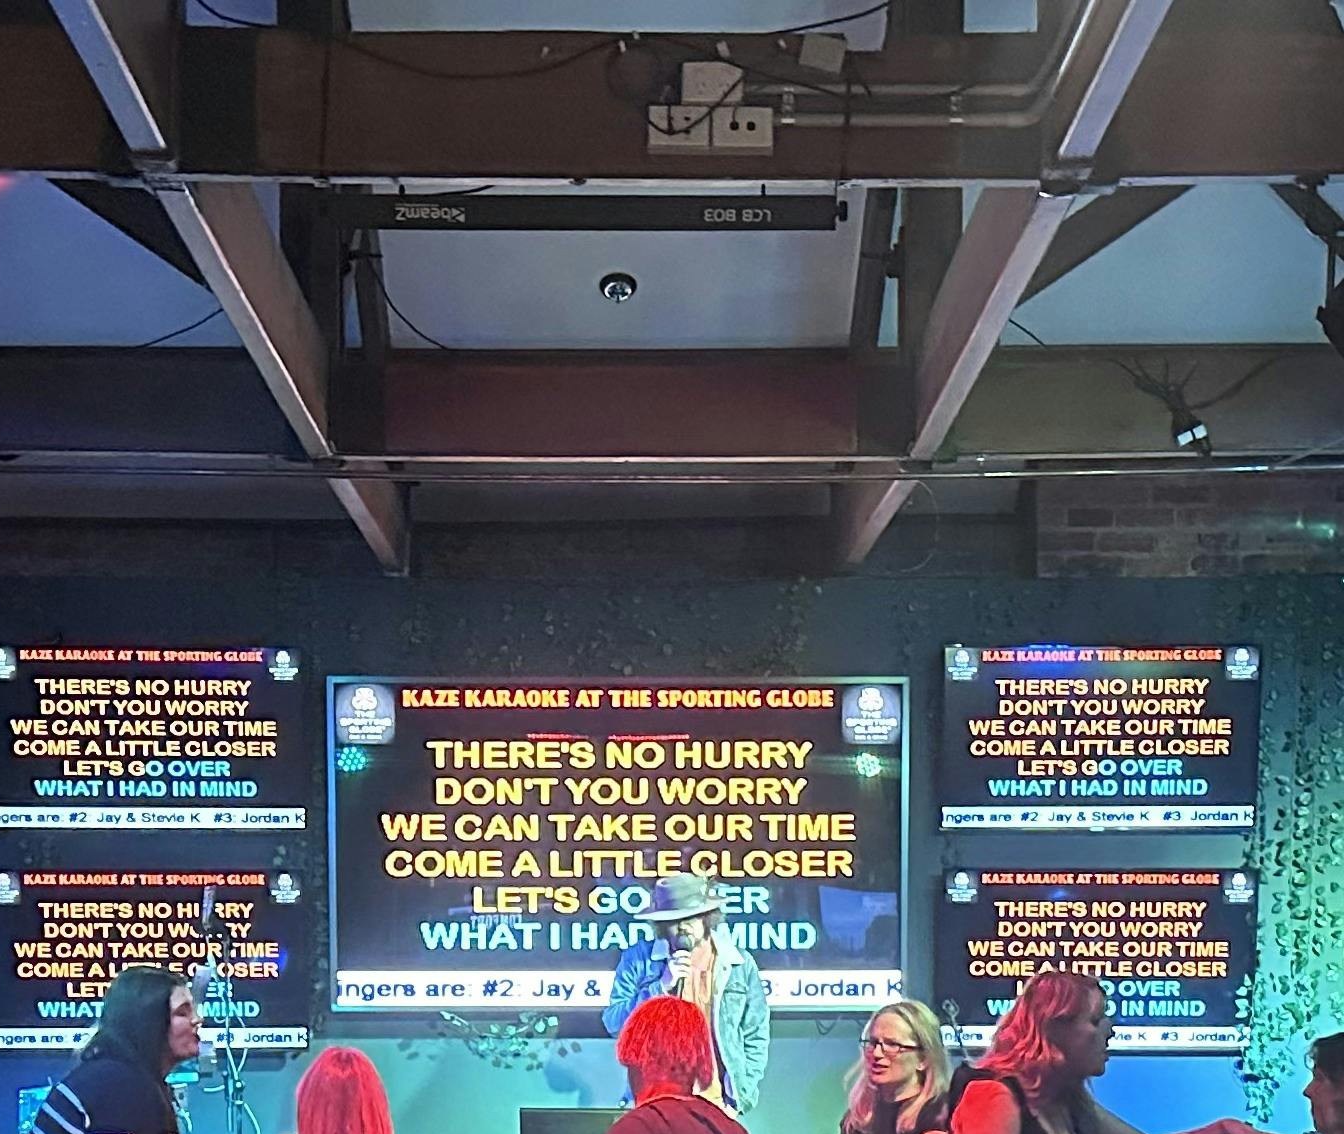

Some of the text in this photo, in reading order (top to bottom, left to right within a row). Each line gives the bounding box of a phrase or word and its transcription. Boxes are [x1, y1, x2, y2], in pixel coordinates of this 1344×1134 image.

[20, 650, 263, 662] KAZE KARAOKE AT THE SPORTING GLOBE
[982, 650, 1222, 661] KAZE KARAOKE AT THE SPORTING GLOBE
[34, 679, 251, 696] THERE'S NO HURRY
[995, 679, 1209, 695] THERE'S NO HURRY
[402, 690, 833, 707] KAZE KARAOKE AT THE SPORTING GLOBE
[40, 699, 249, 716] DON'T YOU WORRY
[999, 699, 1205, 716] DON'T YOU WORRY
[10, 720, 277, 737] WE CAN TAKE OUR TIME
[969, 719, 1231, 736] WE CAN TAKE OUR TIME
[14, 740, 276, 757] COME A LITTLE CLOSER
[427, 741, 812, 769] THERE'S NO HURRY
[970, 740, 1229, 756] COME A LITTLE CLOSER
[64, 760, 230, 777] LET'S GO OVER
[1017, 760, 1182, 776] LET'S GO OVER
[34, 780, 257, 797] WHAT I HAD IN MIND
[435, 778, 807, 805] DON'T YOU WORRY
[988, 780, 1208, 796] WHAT I HAD IN MIND
[97, 813, 121, 824] Jay
[127, 813, 136, 822] &
[191, 813, 200, 822] K
[242, 813, 289, 822] Jordan
[1141, 811, 1149, 820] K
[382, 814, 856, 842] WE CAN TAKE OUR TIME
[384, 850, 853, 878] COME A LITTLE CLOSER
[472, 886, 652, 914] LET'S GO
[38, 903, 172, 918] THERE'S NO
[994, 902, 1206, 918] THERE'S NO HURRY
[44, 923, 163, 938] DON'T YOU
[421, 922, 542, 950] WHAT
[549, 922, 560, 950] I
[998, 922, 1202, 938] DON'T YOU WORRY
[14, 942, 51, 959] WE
[56, 942, 103, 959] CAN
[108, 942, 169, 959] TAKE
[173, 942, 222, 959] OUR
[968, 942, 1228, 957] WE CAN TAKE OUR TIME
[17, 963, 84, 978] COME
[88, 963, 105, 978] A
[969, 962, 1035, 977] COME
[1136, 962, 1227, 977] CLOSER
[532, 980, 575, 1001] Jay
[584, 980, 601, 997] &
[790, 979, 875, 996] Jordan
[1119, 981, 1181, 997] OVER
[38, 1002, 104, 1018] WHAT
[1122, 1000, 1205, 1016] IN MIND
